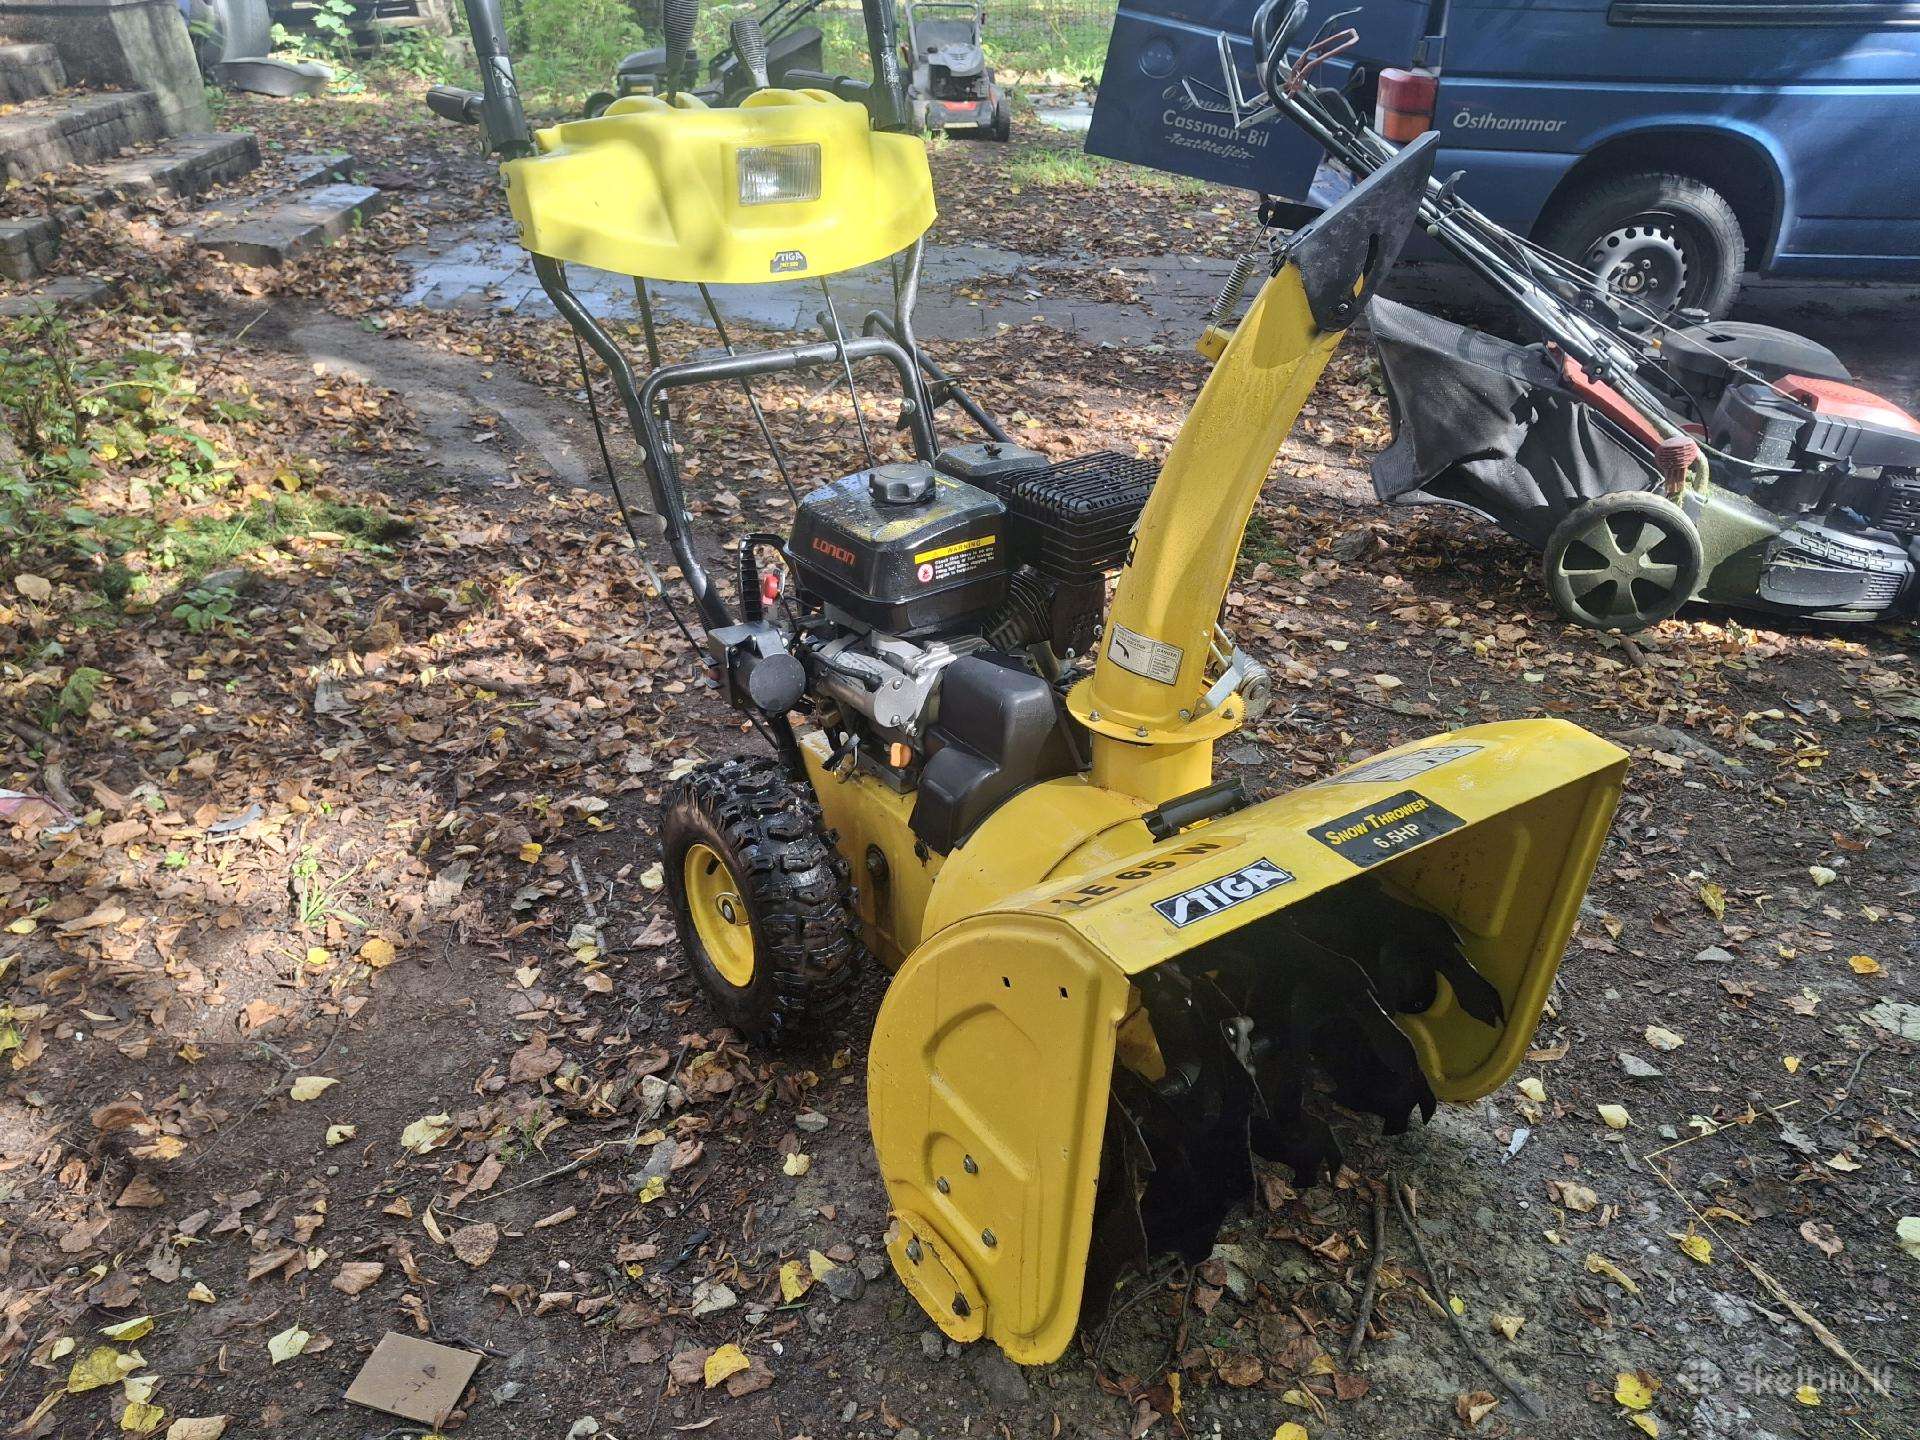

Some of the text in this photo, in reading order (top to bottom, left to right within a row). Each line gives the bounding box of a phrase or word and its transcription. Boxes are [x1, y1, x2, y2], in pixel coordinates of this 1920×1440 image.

[1162, 109, 1270, 147] Cassman-Bil
[1452, 107, 1567, 132] Östhammar
[946, 540, 982, 554] WARNING
[1115, 860, 1167, 880] 65
[1171, 866, 1289, 924] STIGA
